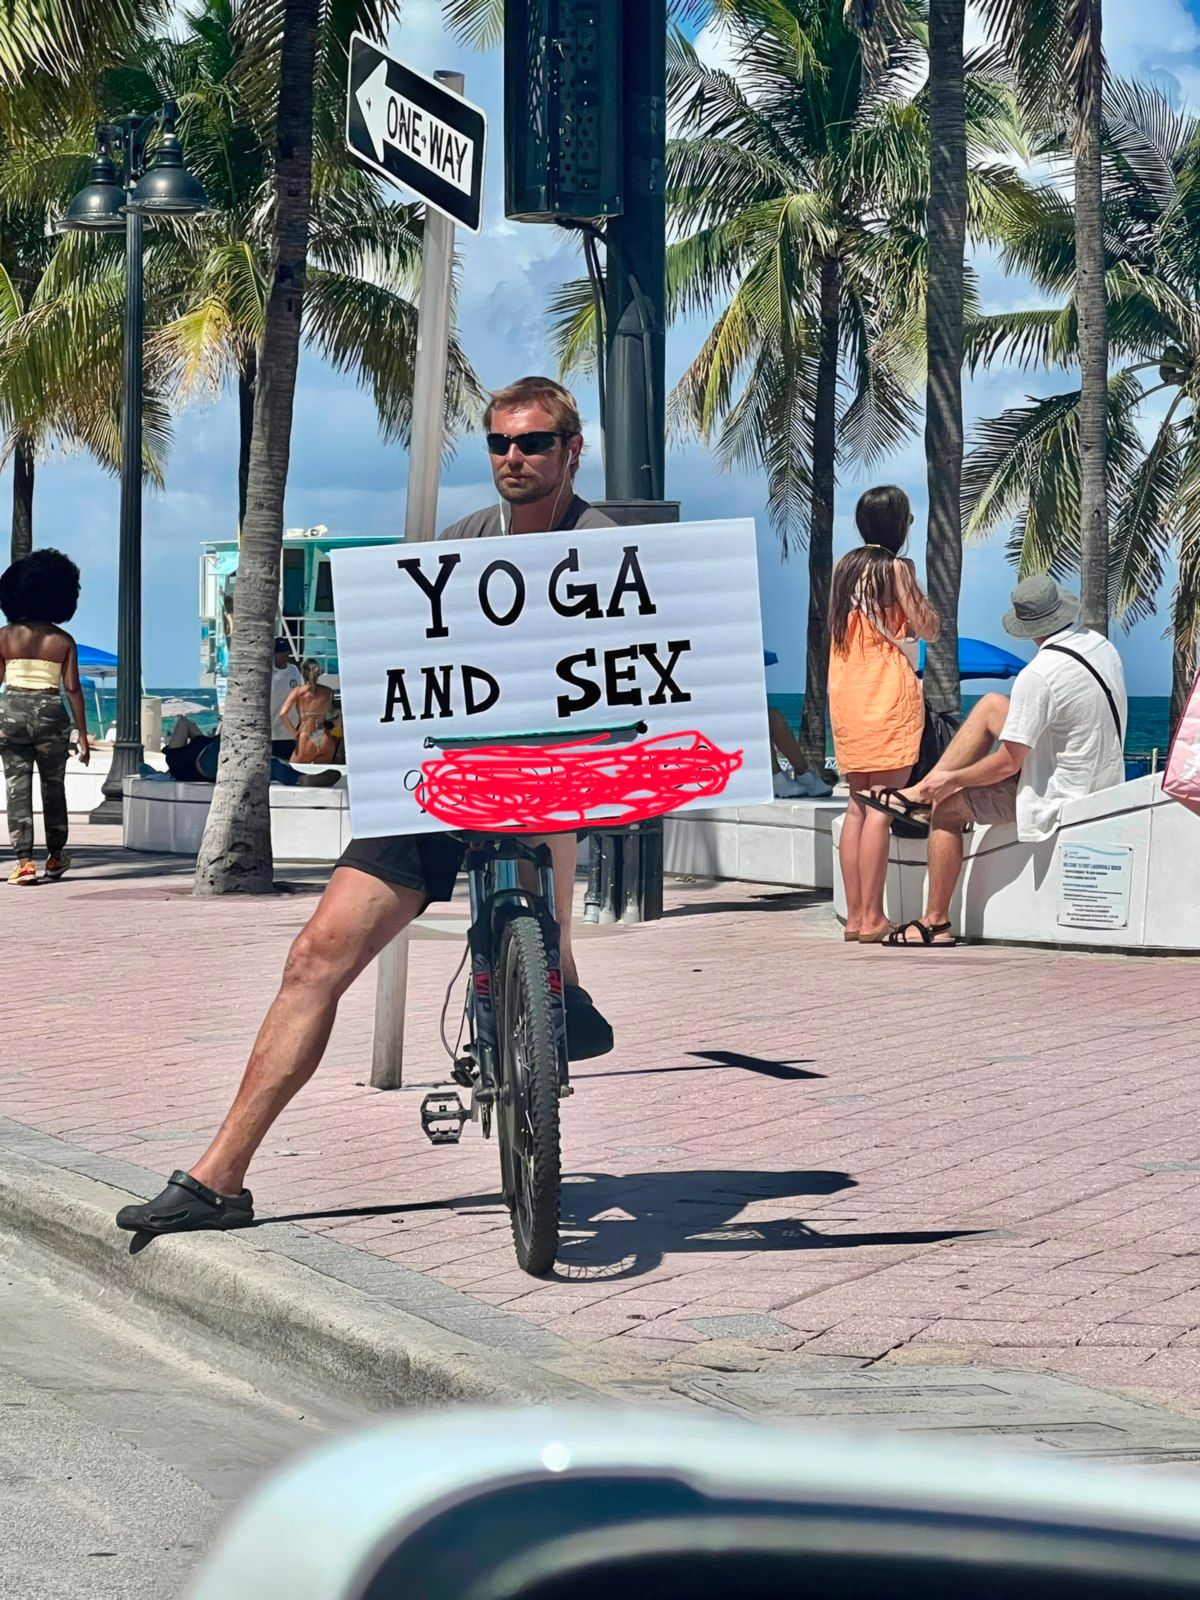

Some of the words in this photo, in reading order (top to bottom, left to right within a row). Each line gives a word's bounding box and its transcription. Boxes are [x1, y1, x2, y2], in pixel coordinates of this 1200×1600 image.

[387, 95, 422, 157] ONE
[429, 119, 468, 183] WAY
[397, 545, 657, 638] YOGA
[380, 664, 500, 723] AND
[555, 639, 692, 718] SEX
